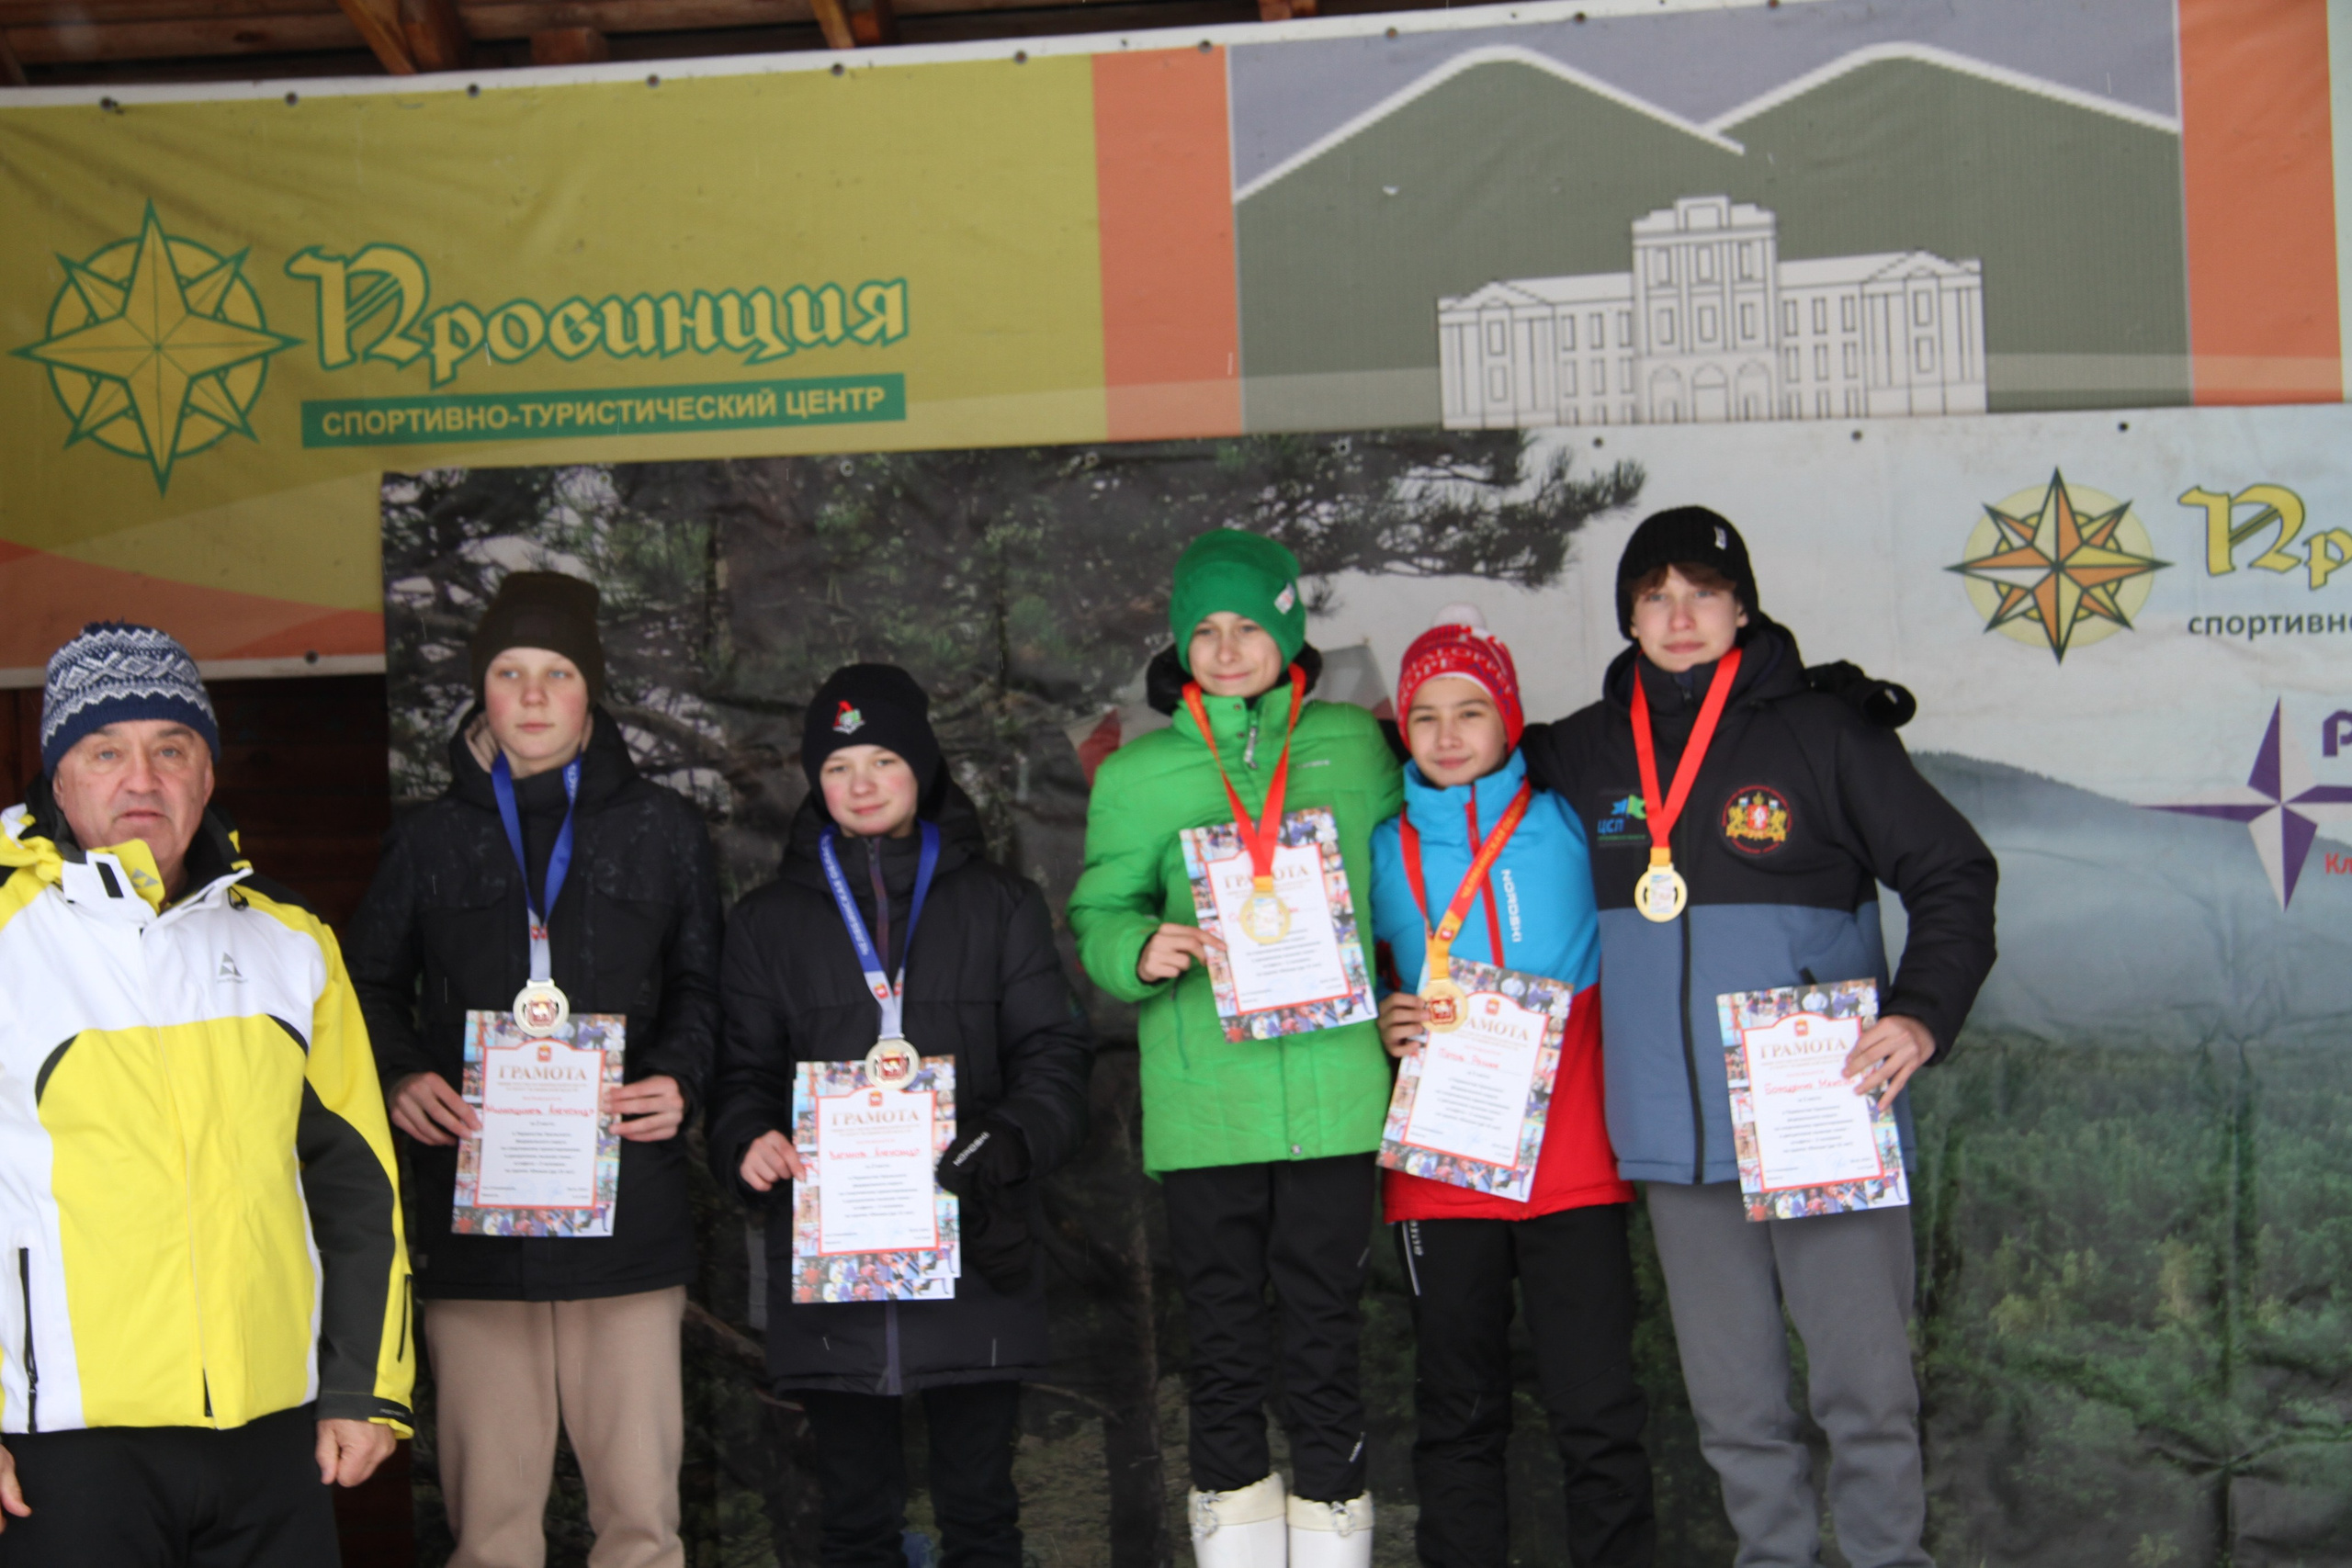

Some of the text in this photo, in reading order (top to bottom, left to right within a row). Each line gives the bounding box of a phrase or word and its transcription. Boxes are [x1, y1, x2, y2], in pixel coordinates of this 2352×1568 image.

[286, 243, 908, 387] Провинция
[322, 386, 885, 437] СПОРТИВНО-ТУРИСТИЧЕСКИЙ ЦЕНТР
[2188, 613, 2352, 641] спортивн
[1597, 818, 1624, 835] ЦСП
[1500, 868, 1522, 943] NORDSKI
[1463, 1016, 1529, 1041] АМОТА
[1760, 1036, 1848, 1059] ГРАМОТА
[499, 1065, 587, 1081] ГРАМОТА
[831, 1109, 920, 1126] ГРАМОТА
